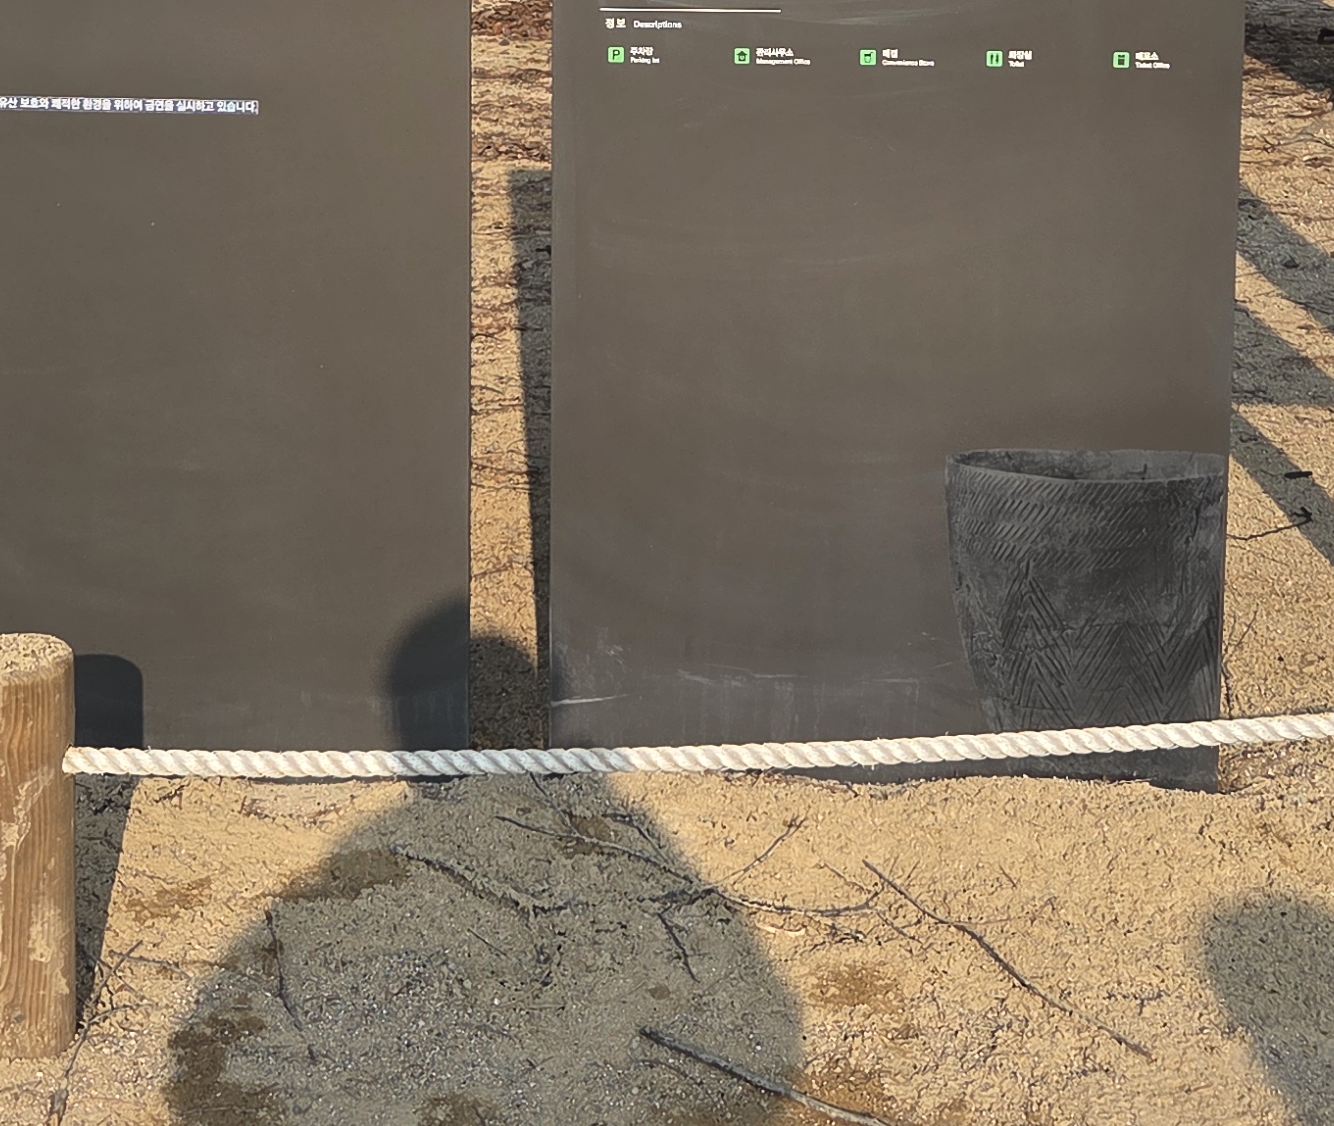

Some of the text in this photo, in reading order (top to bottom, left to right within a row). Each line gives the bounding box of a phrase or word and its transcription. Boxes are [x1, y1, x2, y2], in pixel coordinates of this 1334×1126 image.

[633, 20, 682, 30] Descriptions
[82, 98, 112, 111] 환경을
[113, 99, 143, 111] 위하여
[144, 99, 174, 112] 금연을
[176, 100, 215, 112] 실시하고
